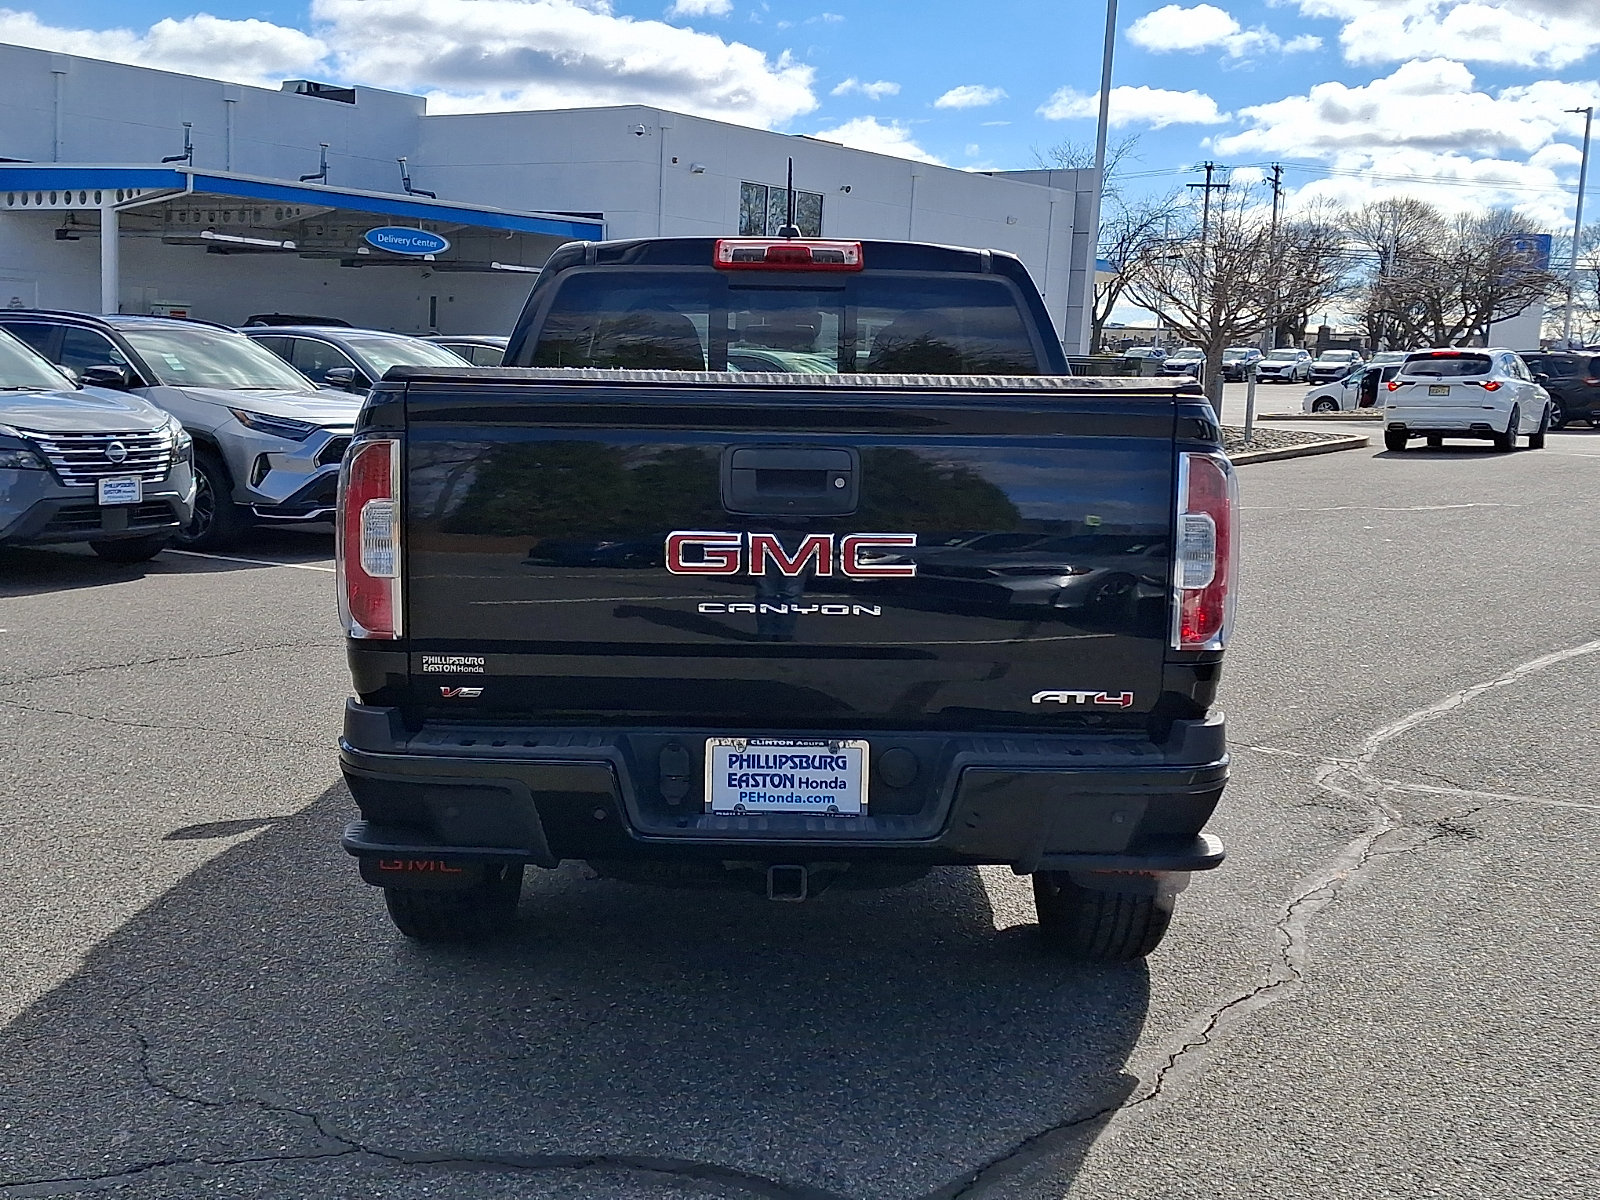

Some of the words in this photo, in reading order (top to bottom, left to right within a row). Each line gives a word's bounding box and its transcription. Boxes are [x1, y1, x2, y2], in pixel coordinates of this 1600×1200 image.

[377, 233, 411, 247] Delivery
[411, 237, 438, 248] Center
[665, 530, 918, 577] GMC
[698, 602, 882, 616] CANYON
[422, 655, 485, 665] PHILLIPSBURG
[423, 663, 457, 673] EASTON
[457, 665, 485, 673] Honda
[1031, 690, 1134, 709] AT4
[728, 753, 847, 772] PHILLIPSBURG
[727, 772, 795, 789] EASTON
[798, 776, 847, 790] Honda
[739, 791, 835, 804] PEHonda.com
